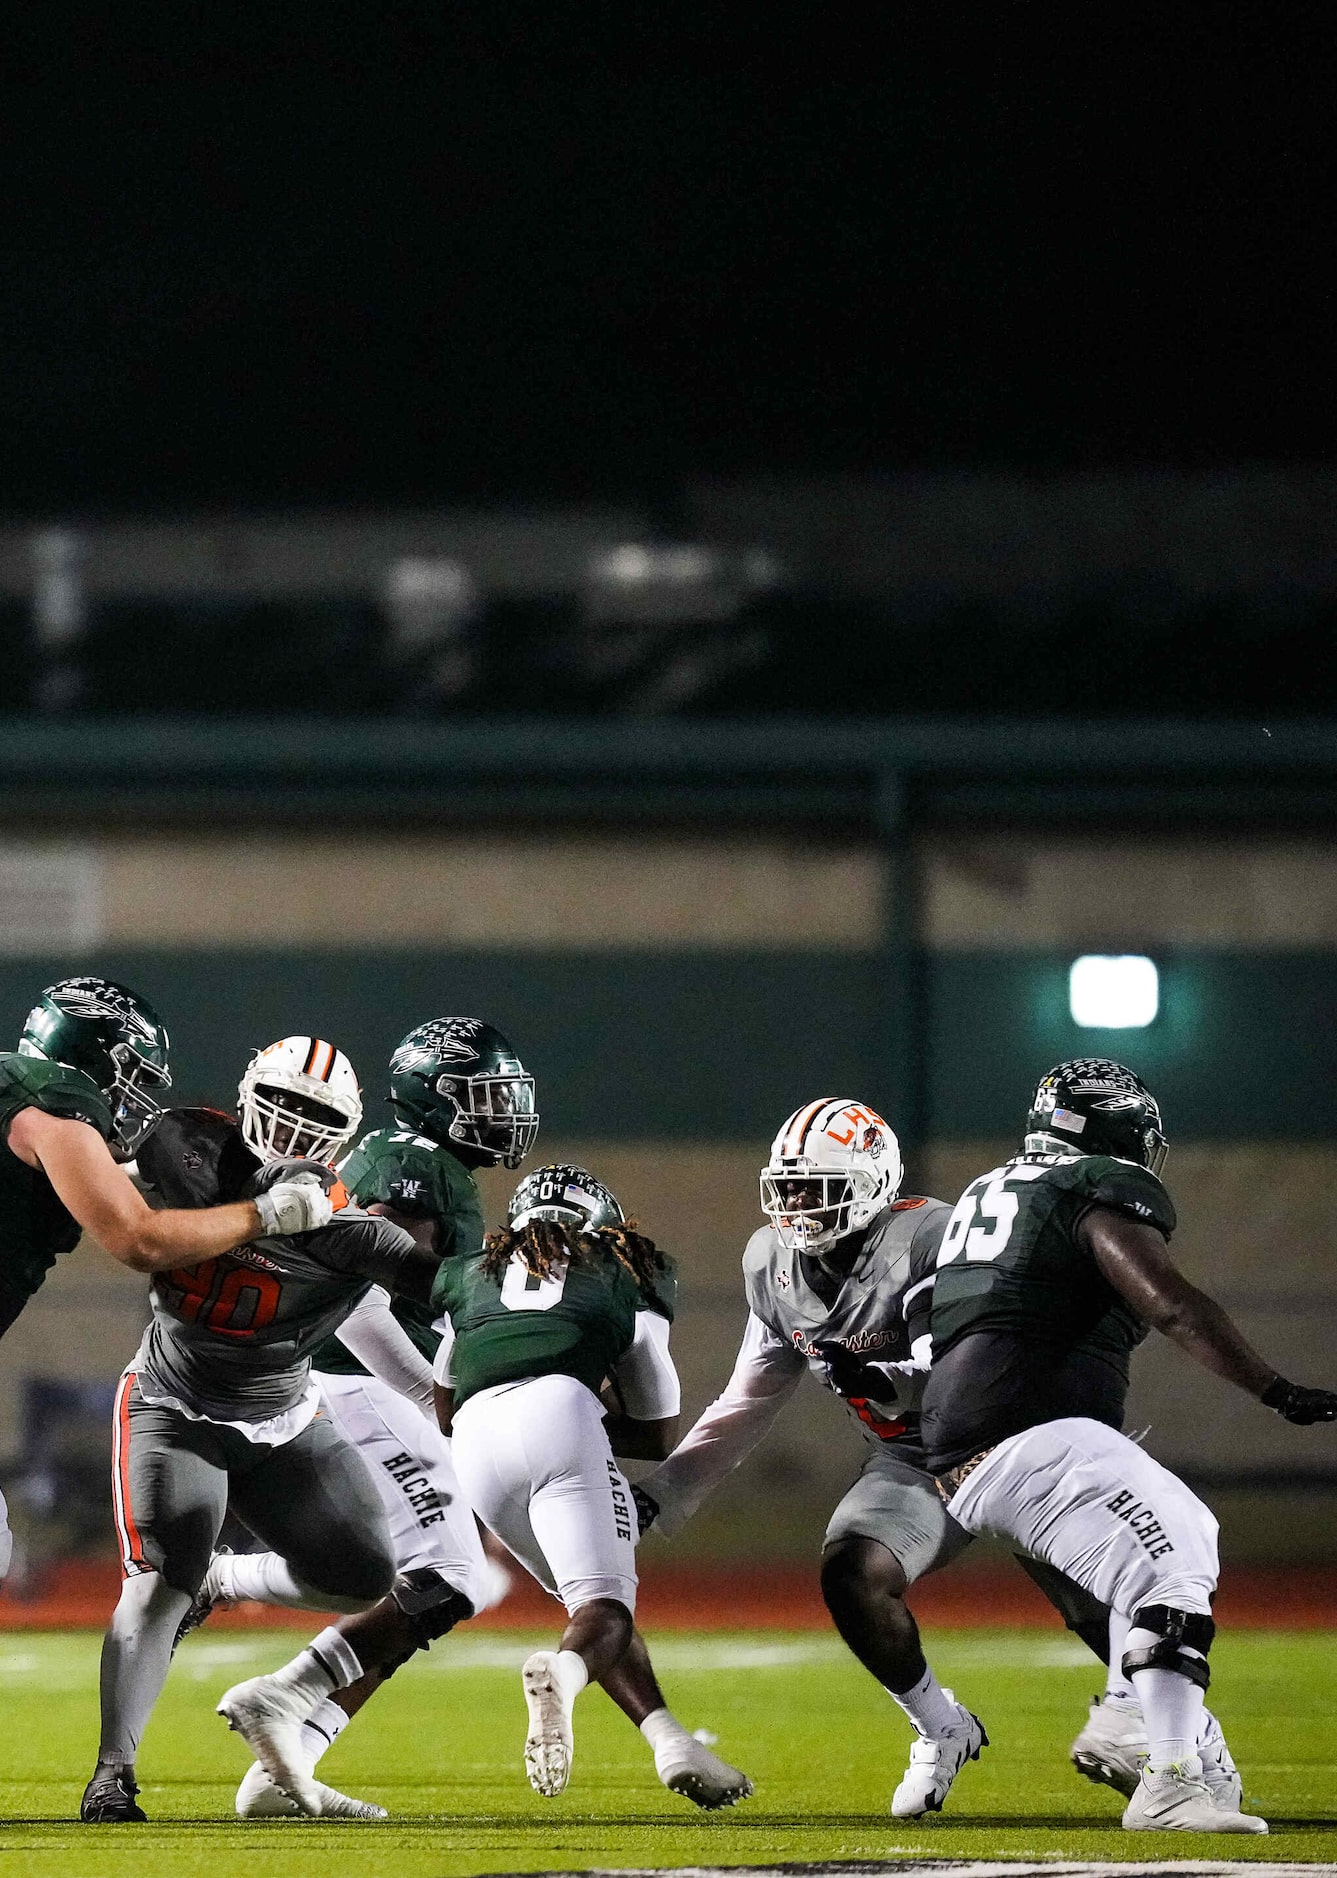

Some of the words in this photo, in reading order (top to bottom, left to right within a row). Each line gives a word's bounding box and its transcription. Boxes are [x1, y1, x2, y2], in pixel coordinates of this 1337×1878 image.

[1034, 1088, 1058, 1112] 65
[540, 1181, 554, 1200] 0
[936, 1164, 1052, 1269] 65
[382, 1452, 446, 1528] HACHIE
[606, 1459, 631, 1541] HACHIE
[1106, 1489, 1175, 1560] HACHIE
